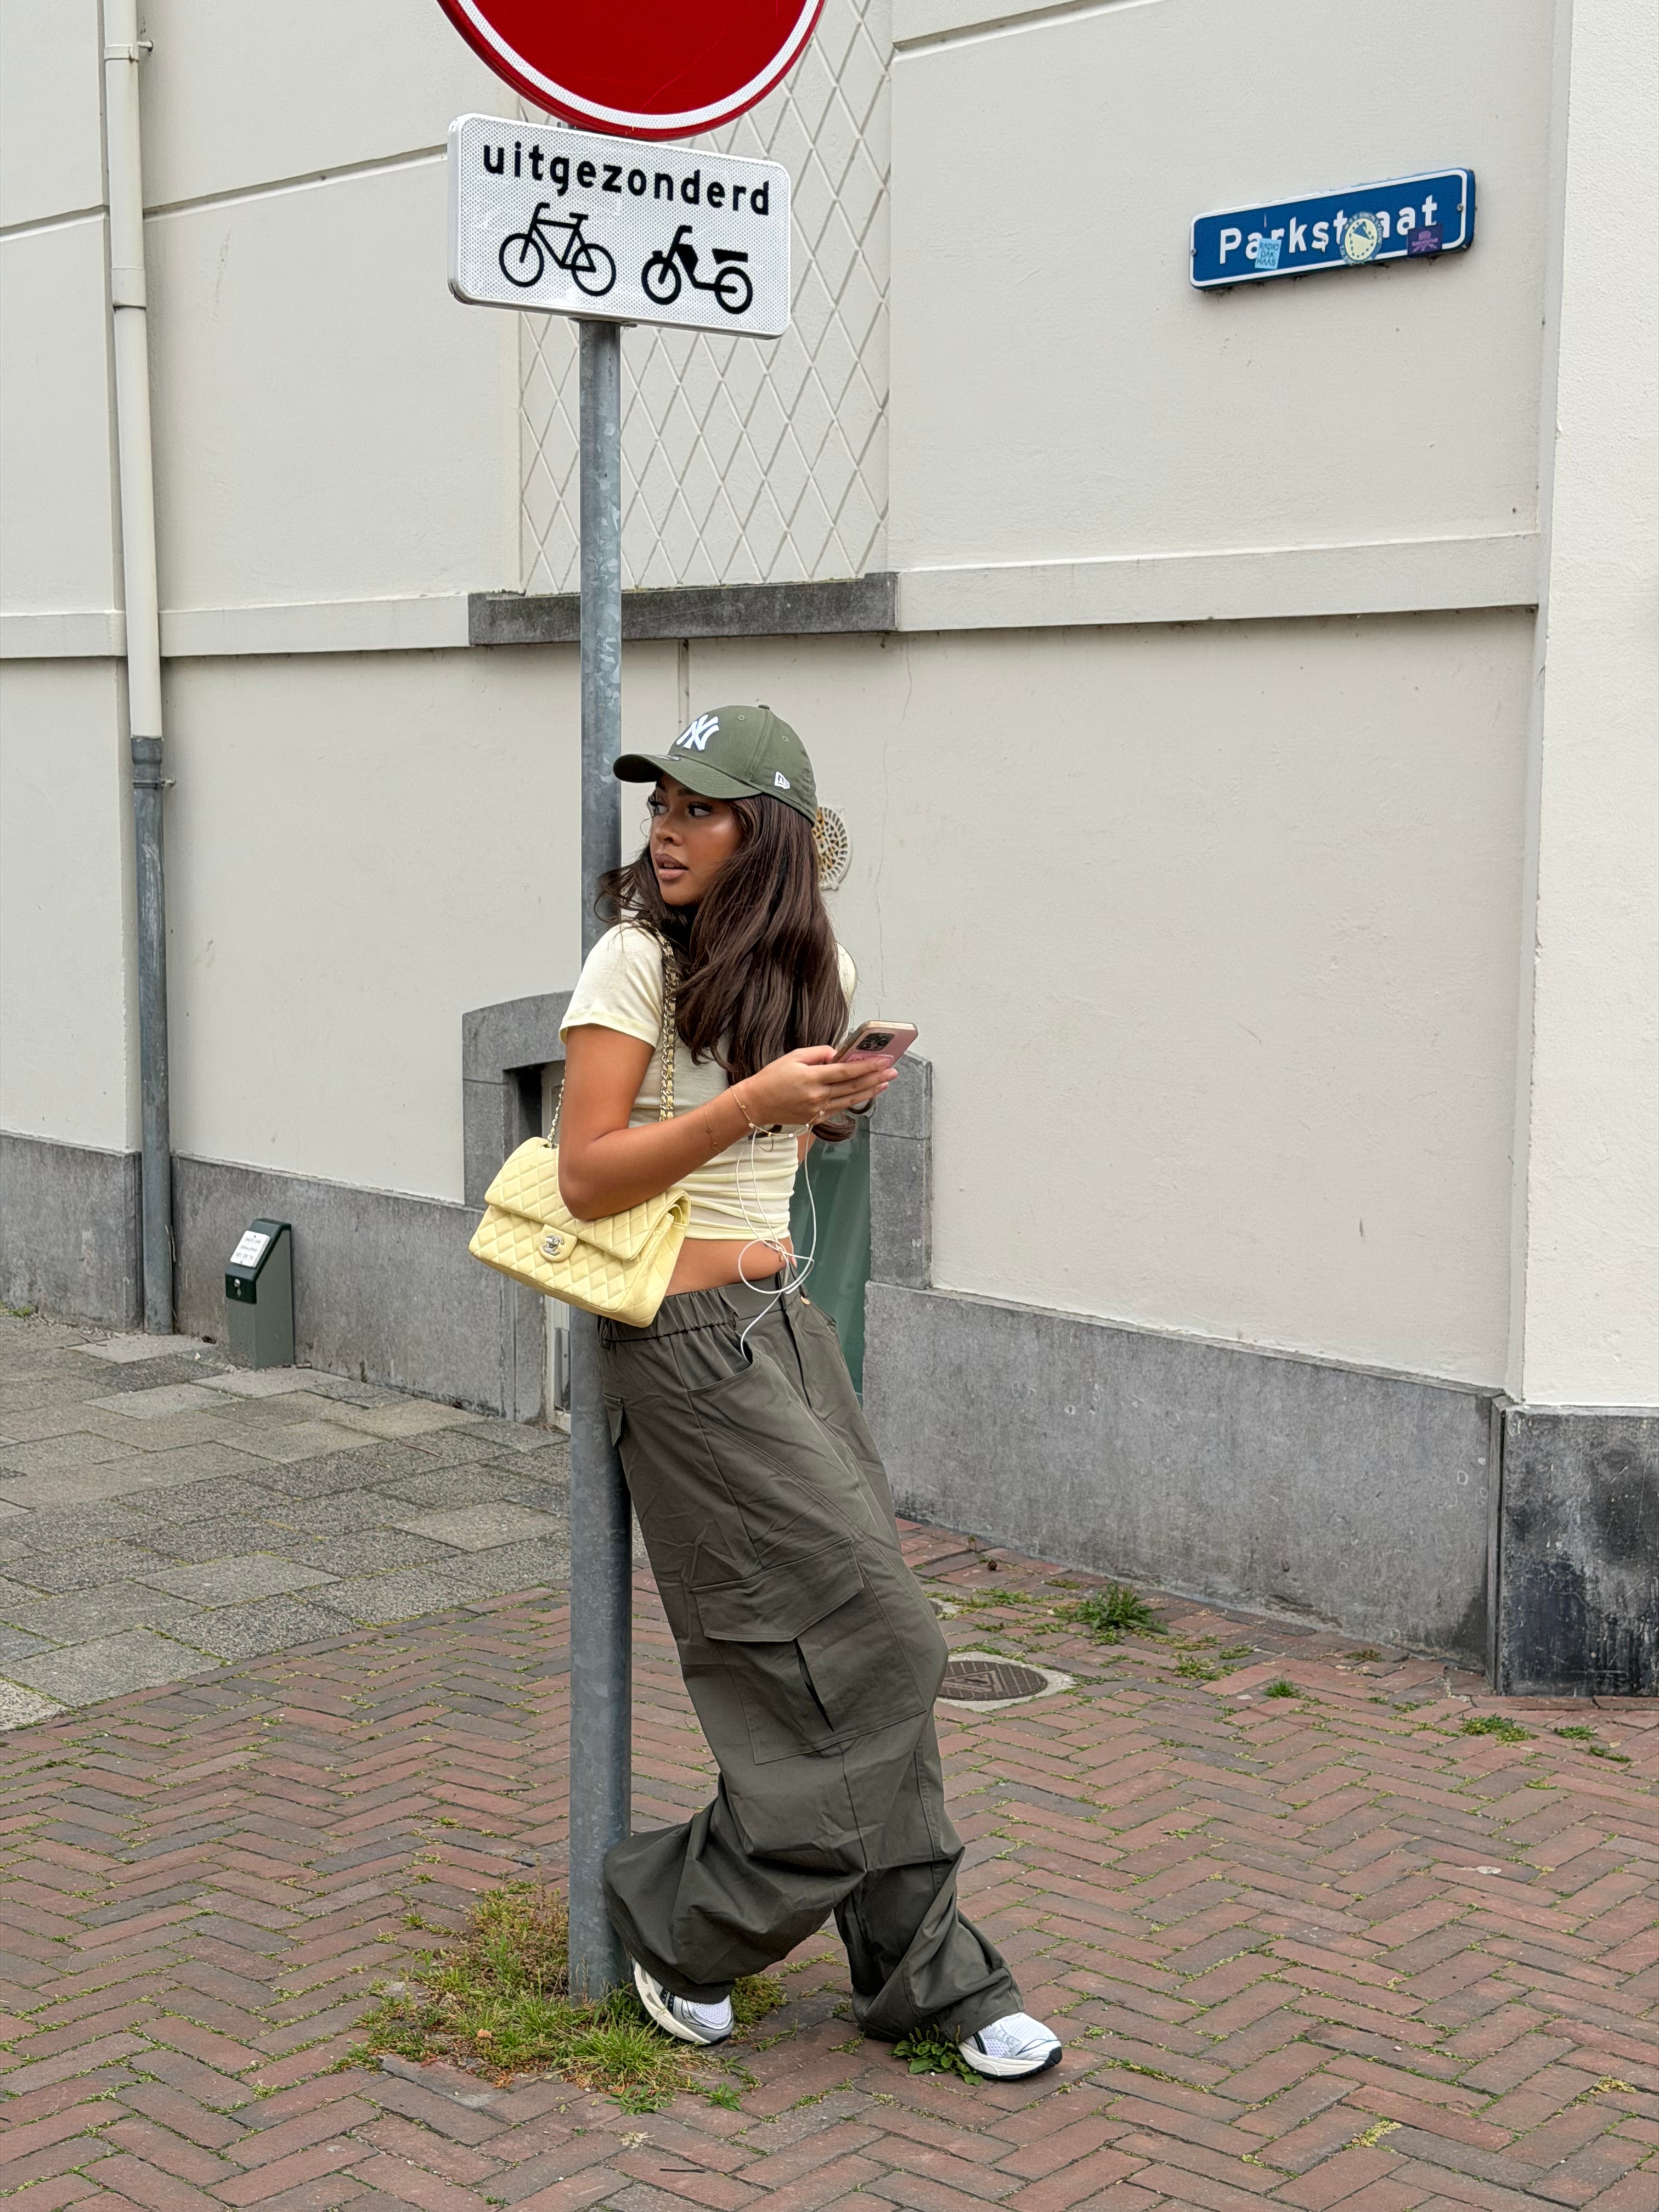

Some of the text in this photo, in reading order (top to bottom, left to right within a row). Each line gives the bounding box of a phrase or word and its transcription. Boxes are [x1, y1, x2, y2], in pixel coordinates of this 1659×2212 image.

[483, 141, 769, 216] uitgezonderd
[1219, 195, 1437, 264] Parkstaat
[676, 714, 720, 752] NY
